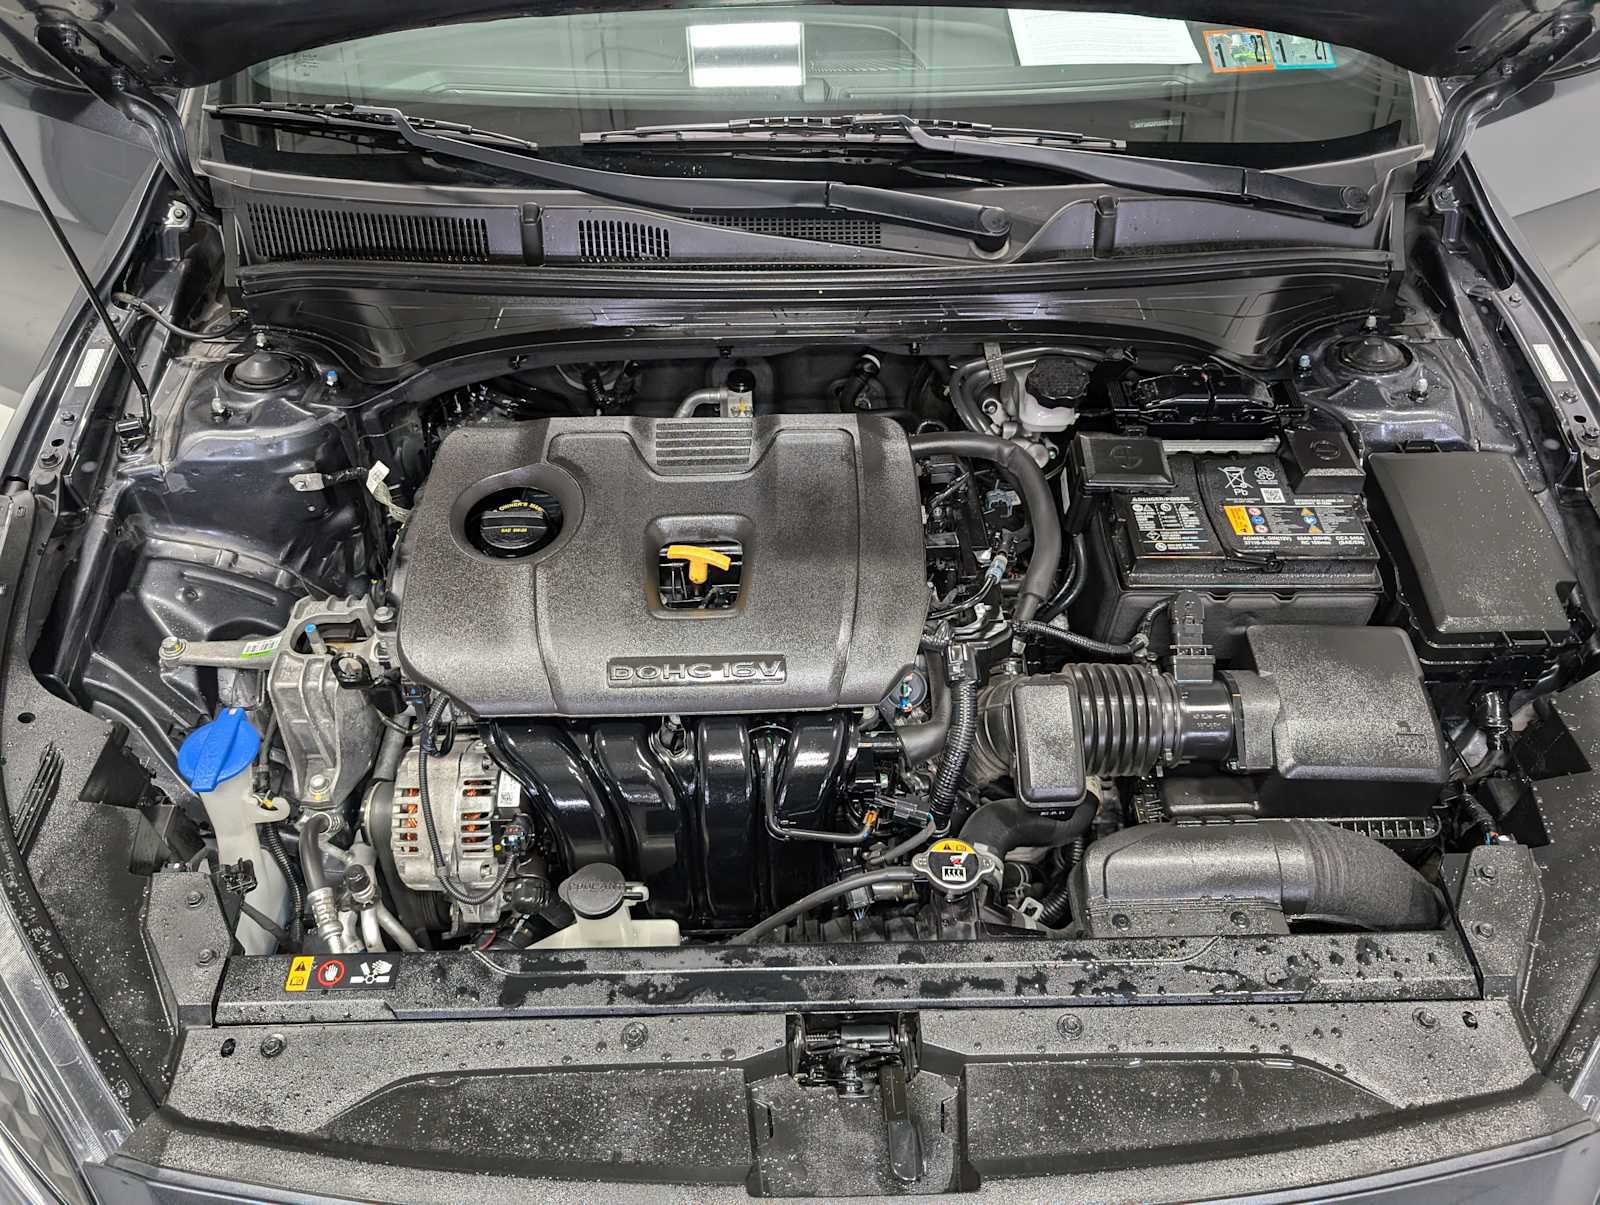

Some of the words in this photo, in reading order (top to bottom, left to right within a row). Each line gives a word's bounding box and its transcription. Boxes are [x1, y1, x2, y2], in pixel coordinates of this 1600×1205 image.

[1215, 43, 1226, 67] 1
[1275, 39, 1287, 63] 1
[610, 662, 712, 681] DOHC
[723, 660, 783, 678] 16V
[568, 879, 625, 892] COOLANT
